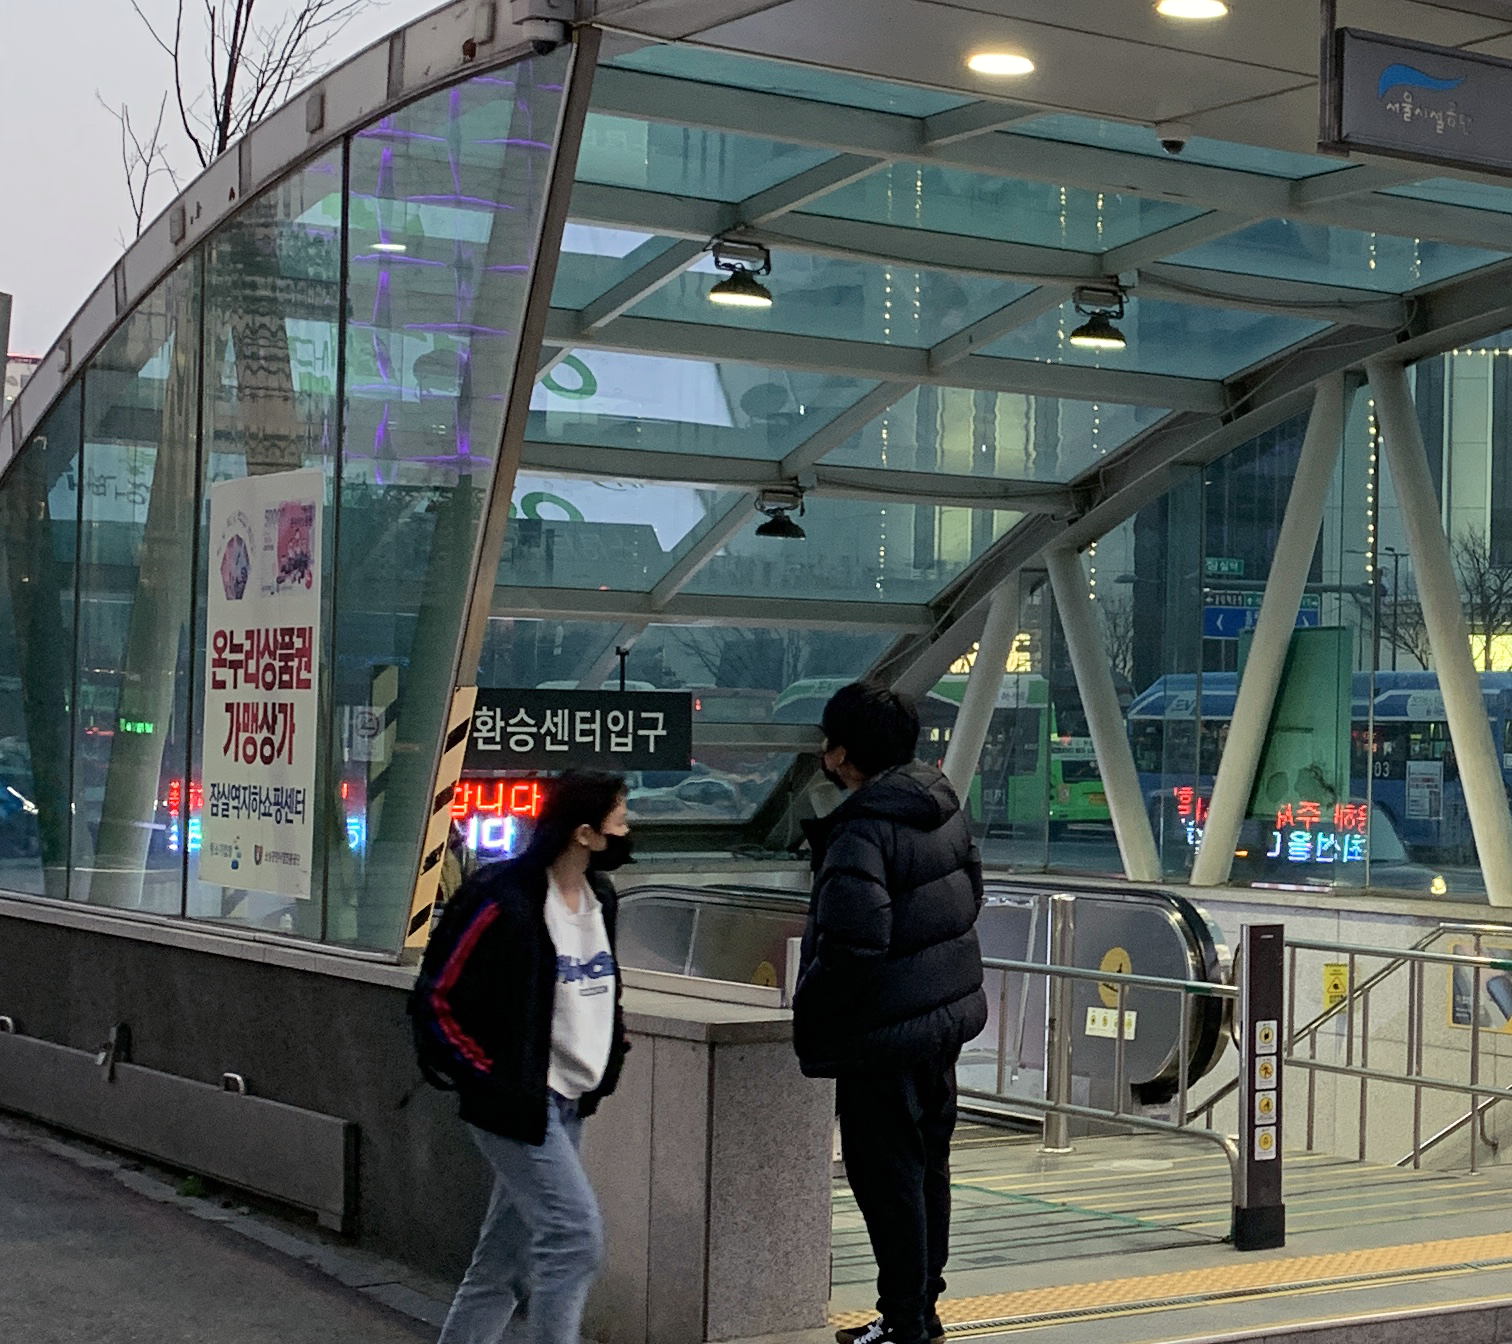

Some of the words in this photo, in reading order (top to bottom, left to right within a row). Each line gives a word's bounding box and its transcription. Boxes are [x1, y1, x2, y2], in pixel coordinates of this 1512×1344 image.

[1386, 90, 1474, 136] 서울시설공단
[211, 626, 313, 691] 온누리상품권
[223, 702, 296, 765] 가맹상가
[1373, 761, 1390, 777] 03
[209, 782, 306, 825] 잠실역지하쇼핑센터
